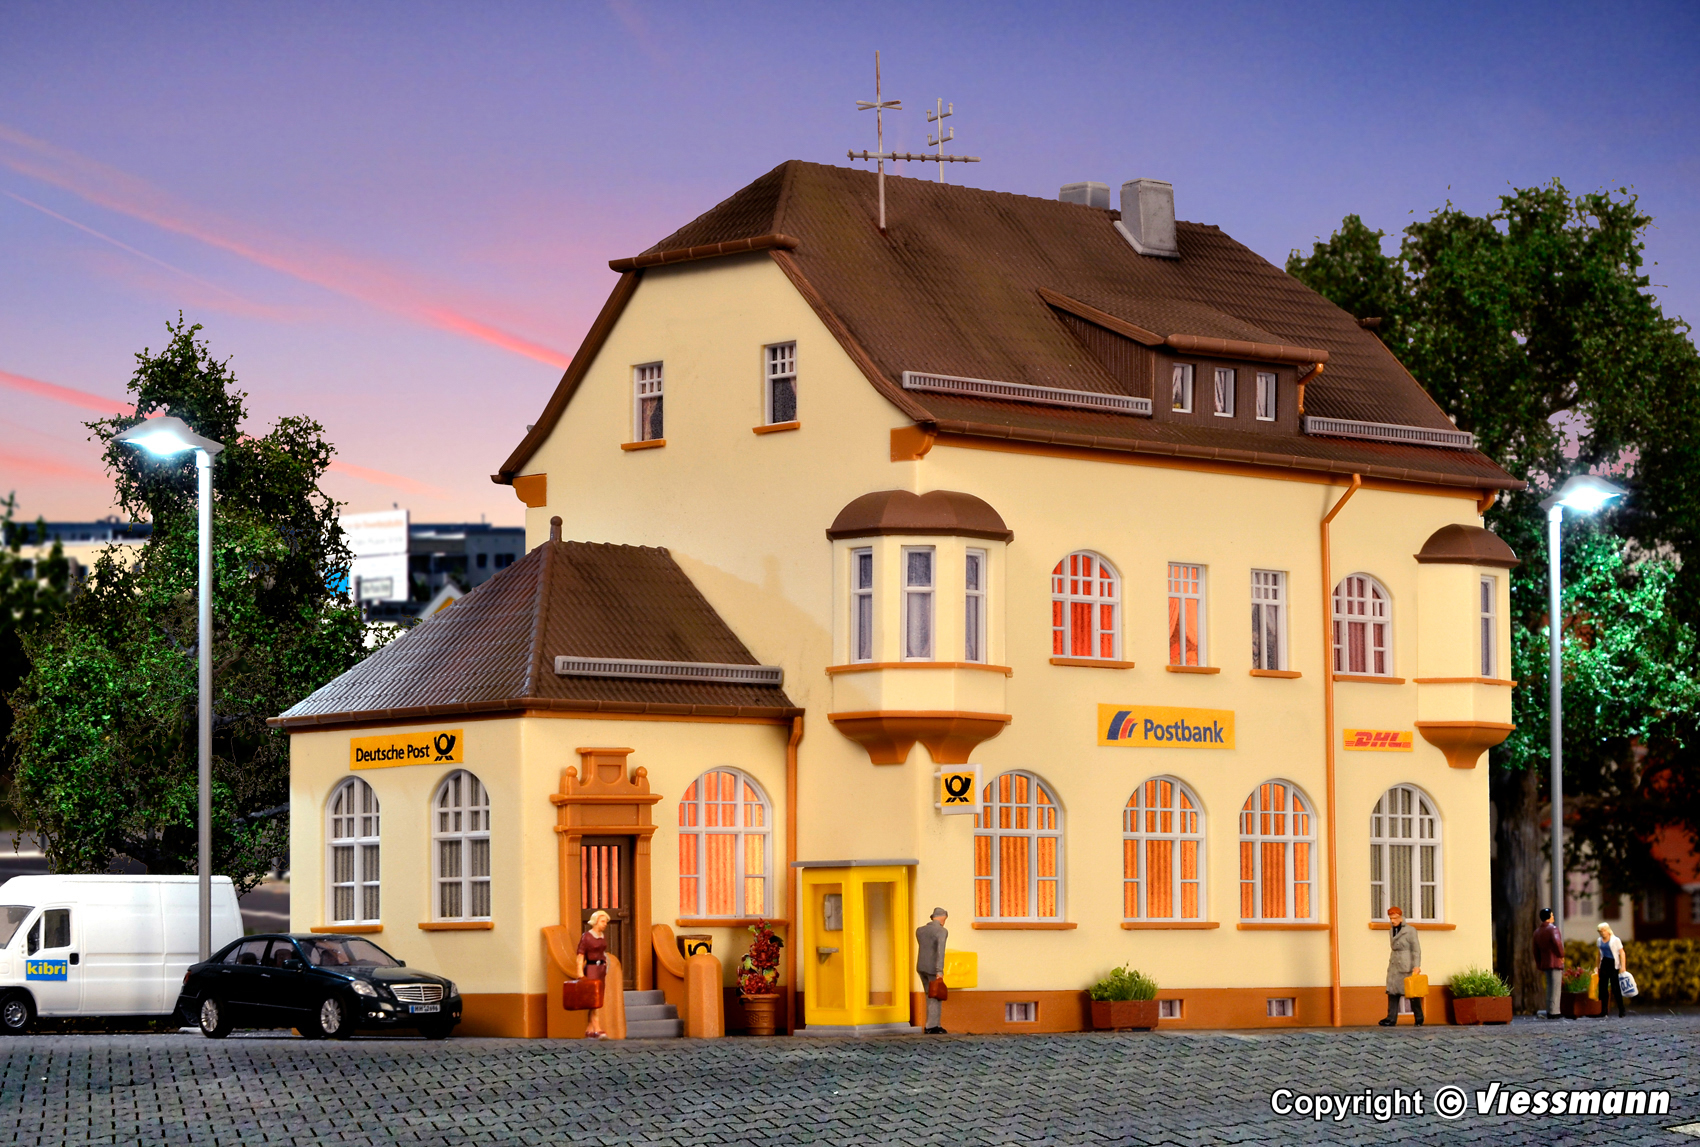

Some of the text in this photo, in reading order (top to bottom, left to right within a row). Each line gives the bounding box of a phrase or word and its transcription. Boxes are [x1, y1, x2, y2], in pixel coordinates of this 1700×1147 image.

[1144, 718, 1225, 743] Postbank
[1354, 731, 1402, 748] DHL
[356, 744, 430, 762] Deutsche Post
[27, 961, 67, 975] kibri
